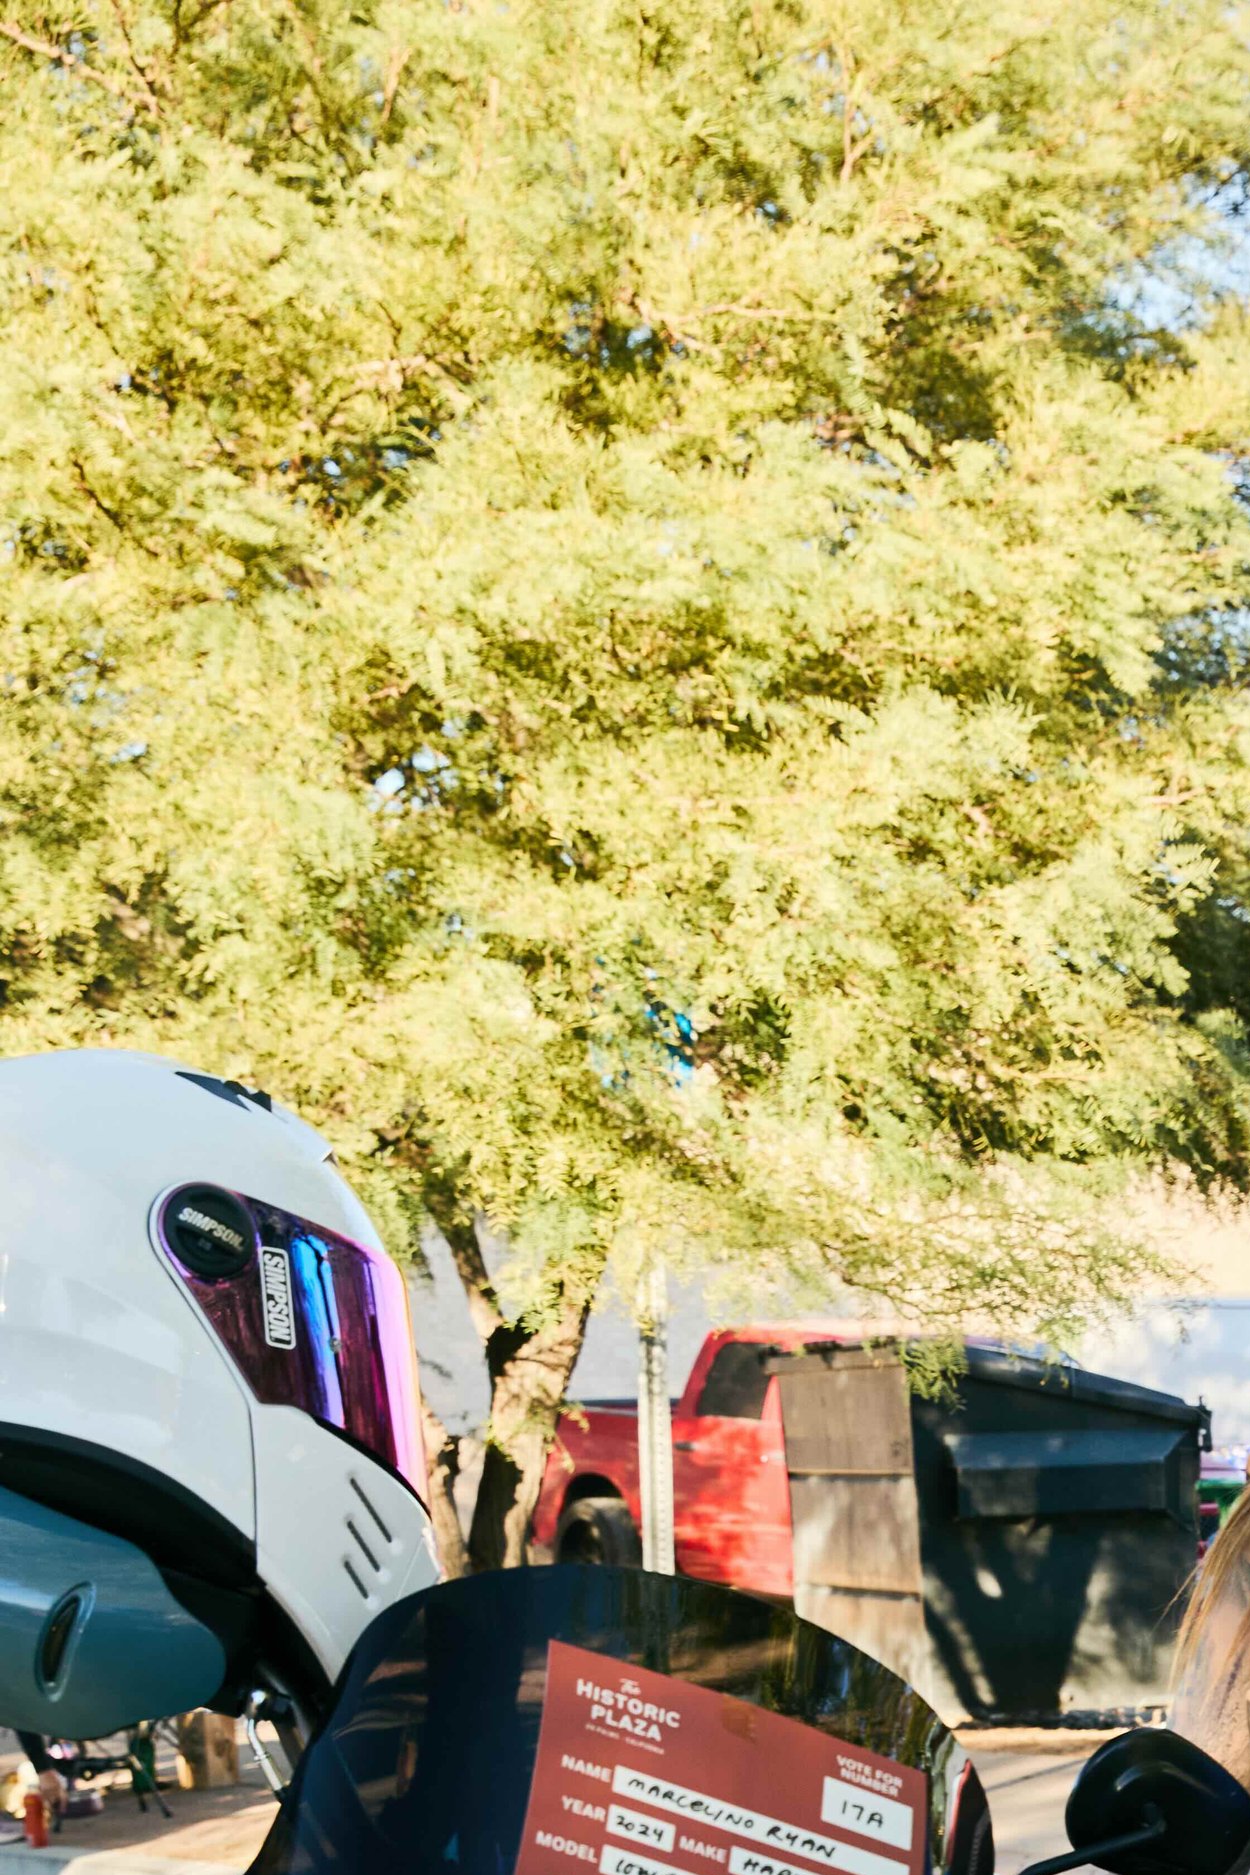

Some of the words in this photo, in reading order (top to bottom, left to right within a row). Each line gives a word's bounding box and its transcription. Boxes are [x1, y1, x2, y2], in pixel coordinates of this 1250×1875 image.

[178, 1207, 244, 1249] SIMPSON
[263, 1253, 291, 1342] SIMPSON
[576, 1678, 680, 1728] HISTORIC
[591, 1704, 662, 1742] PLAZA
[561, 1754, 612, 1783] NAME
[836, 1754, 872, 1777] VOTE
[875, 1770, 903, 1789] FOR
[841, 1768, 899, 1797] NUMBER
[561, 1795, 606, 1822] YEAR
[842, 1800, 883, 1828] 17A
[616, 1815, 664, 1841] 2024
[766, 1825, 835, 1858] RYAN
[535, 1830, 597, 1863] MODEL
[679, 1835, 727, 1864] MAKE
